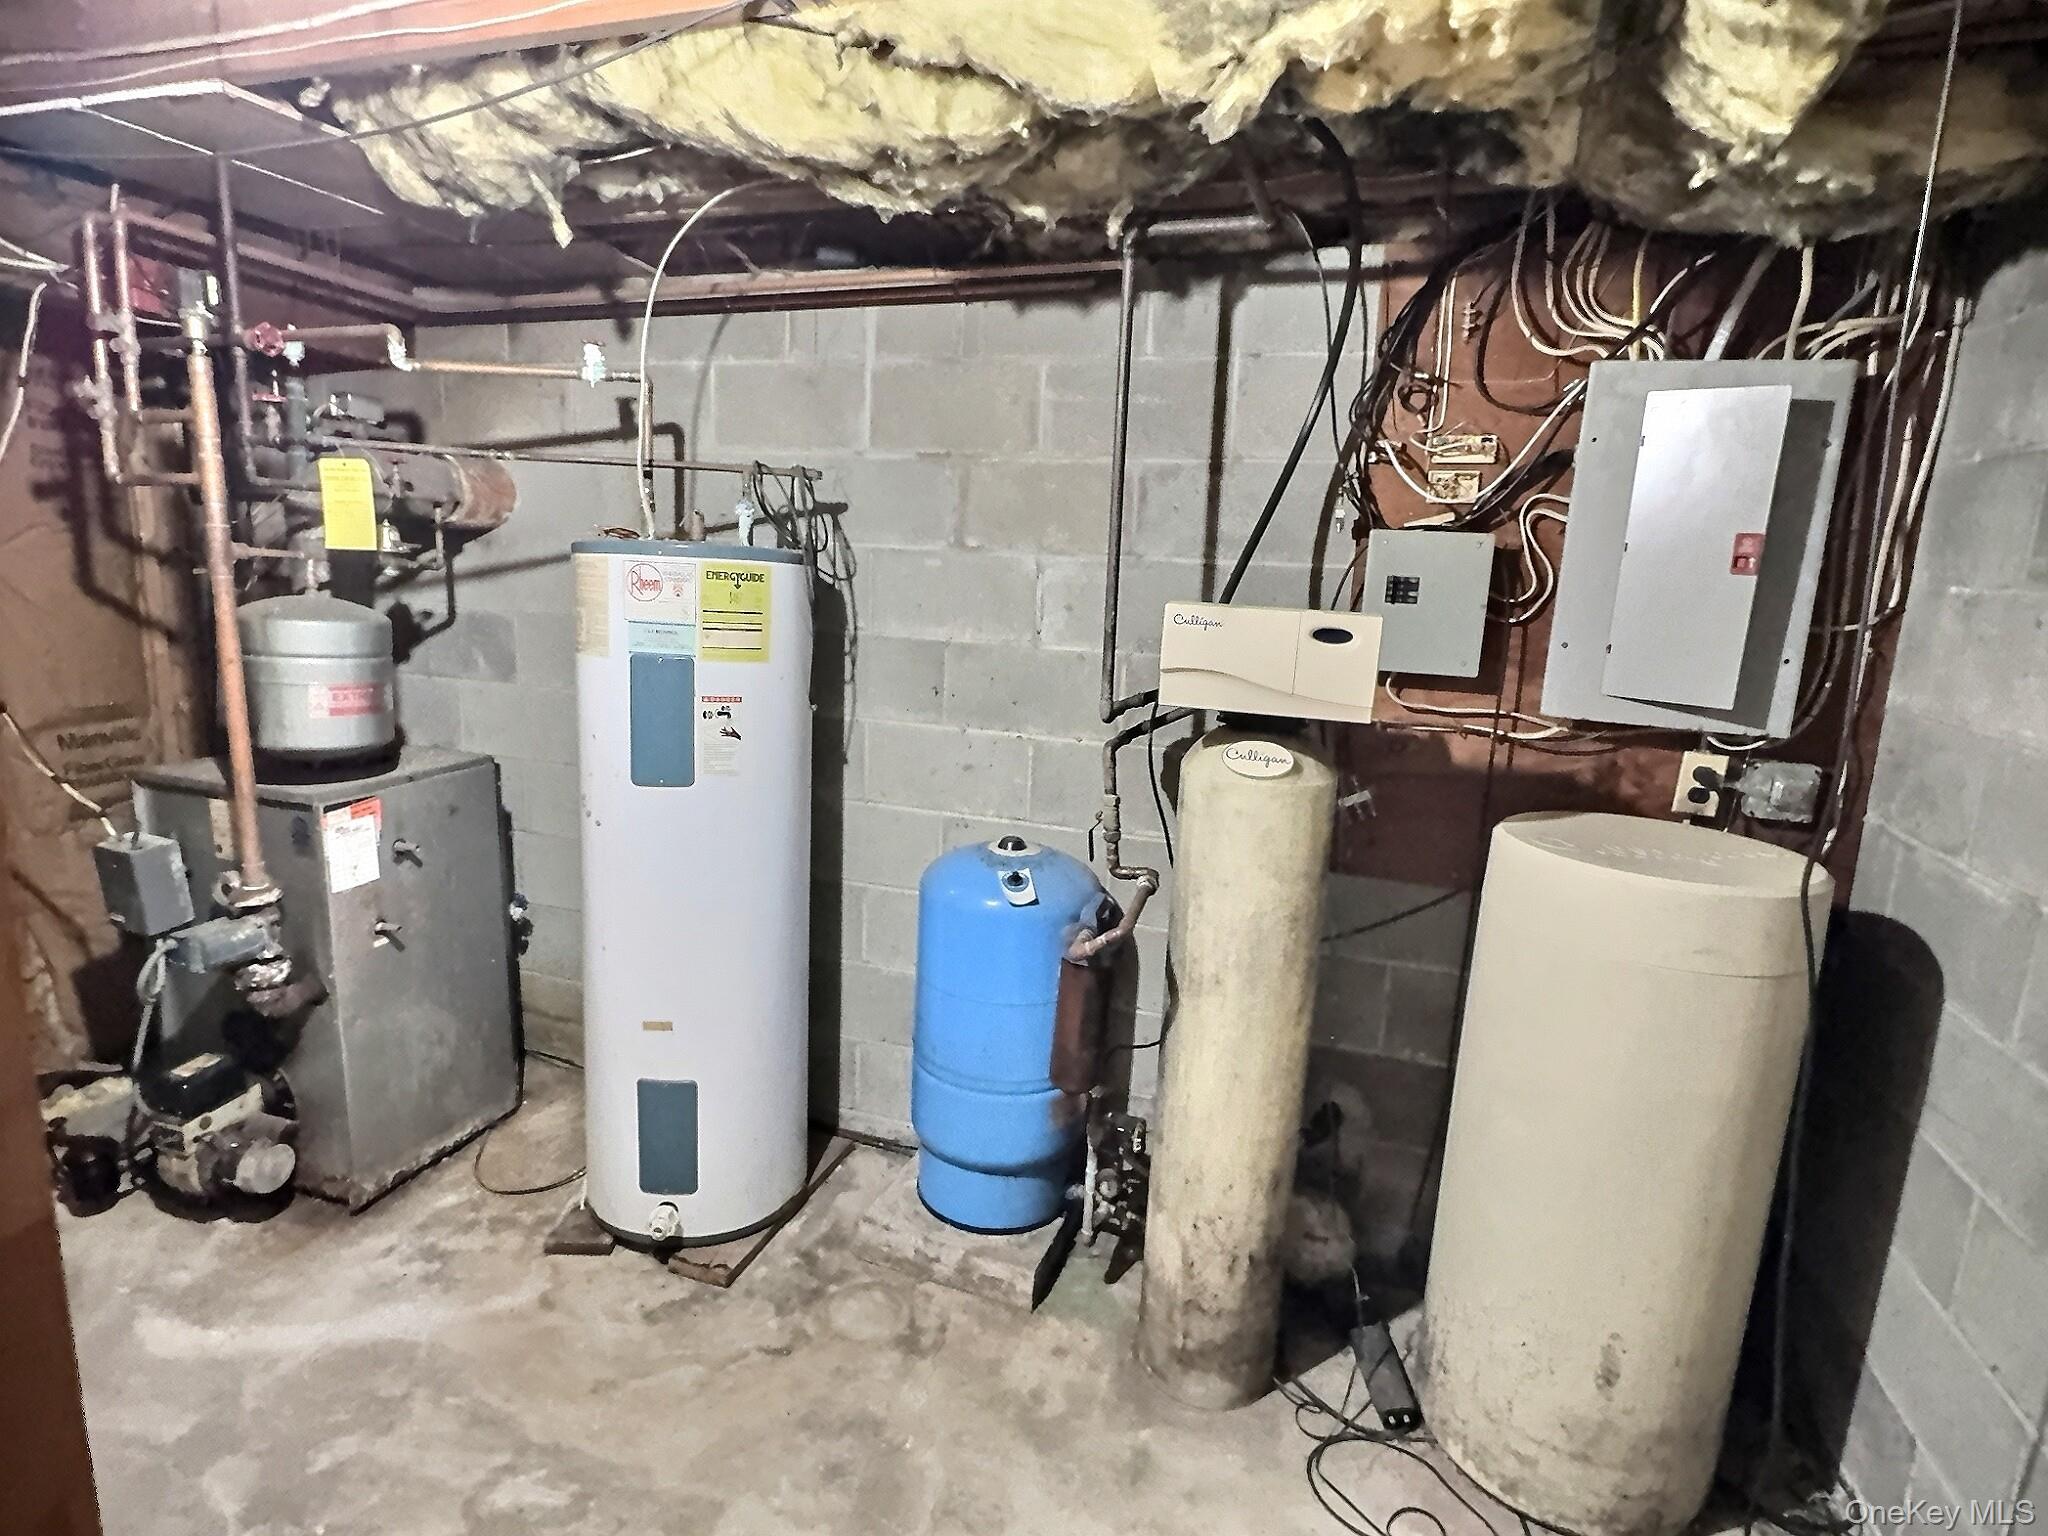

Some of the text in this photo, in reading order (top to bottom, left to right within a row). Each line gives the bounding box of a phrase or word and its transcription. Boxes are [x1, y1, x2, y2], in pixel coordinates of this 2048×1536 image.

[630, 565, 661, 596] Rheem
[1173, 613, 1224, 631] Culligan
[1225, 747, 1291, 768] Culligan
